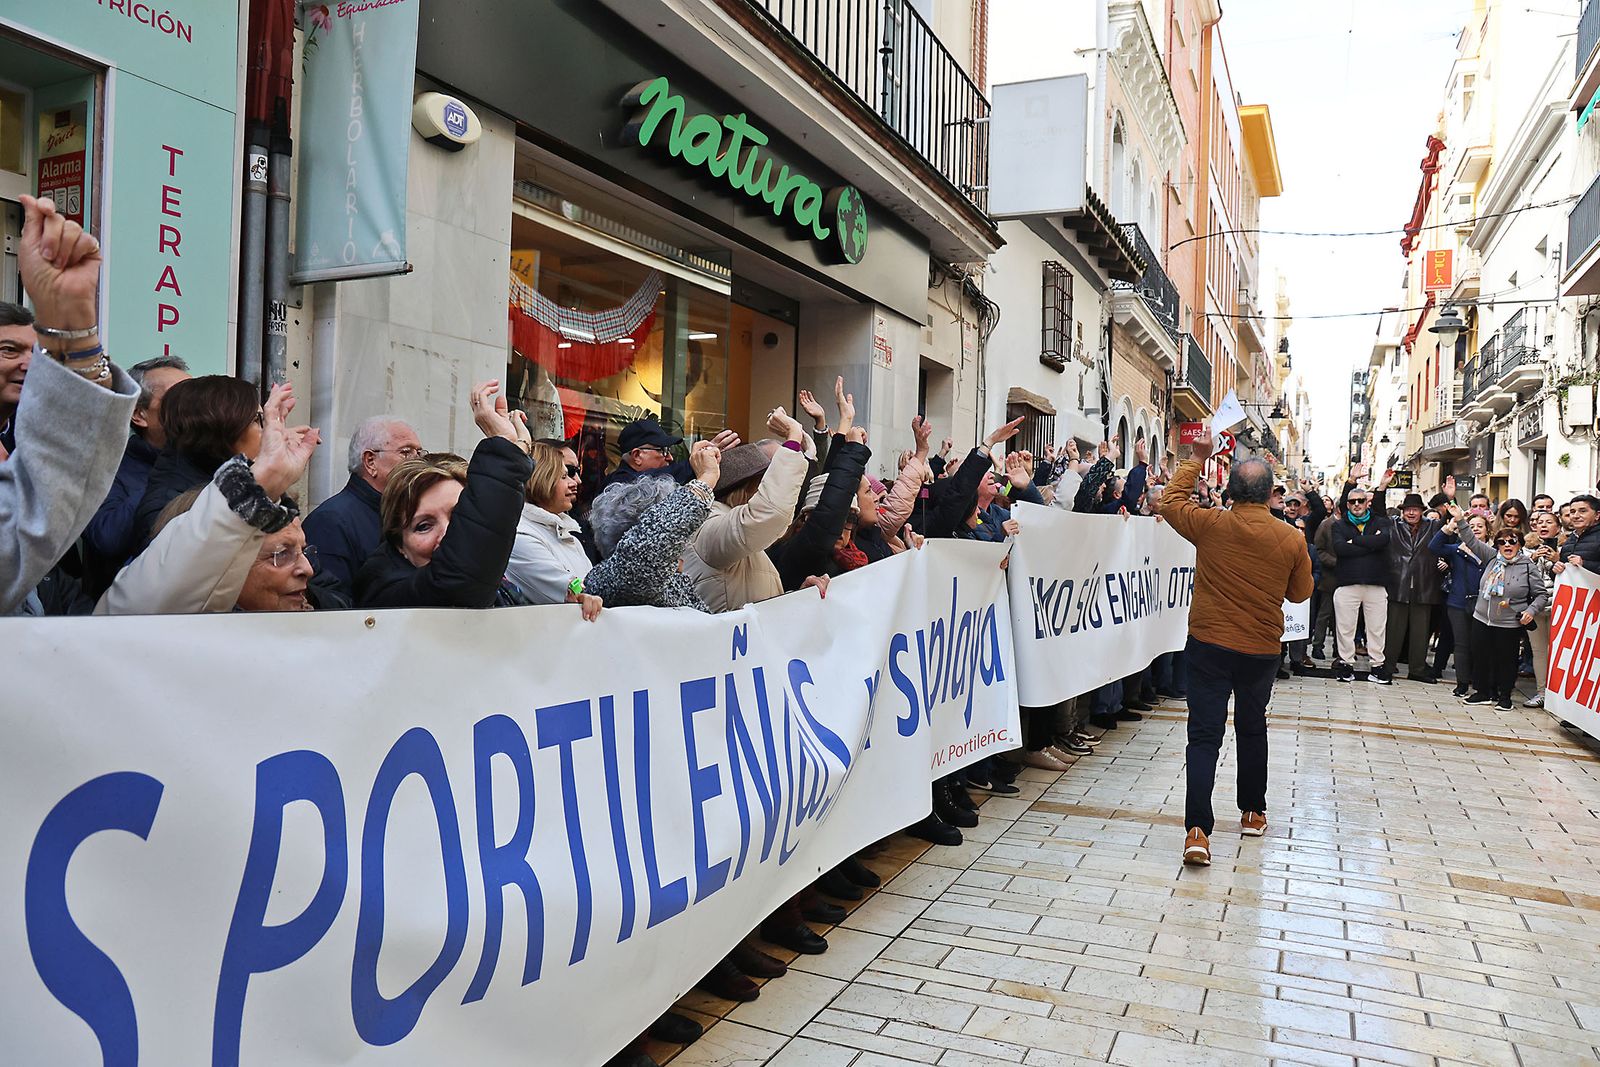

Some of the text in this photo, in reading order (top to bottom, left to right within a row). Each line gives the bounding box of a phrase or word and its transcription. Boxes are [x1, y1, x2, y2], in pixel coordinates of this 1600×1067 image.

[343, 22, 366, 264] HERBOLARIO
[447, 111, 464, 127] ADT
[639, 76, 830, 240] natura
[41, 159, 81, 179] Alarma
